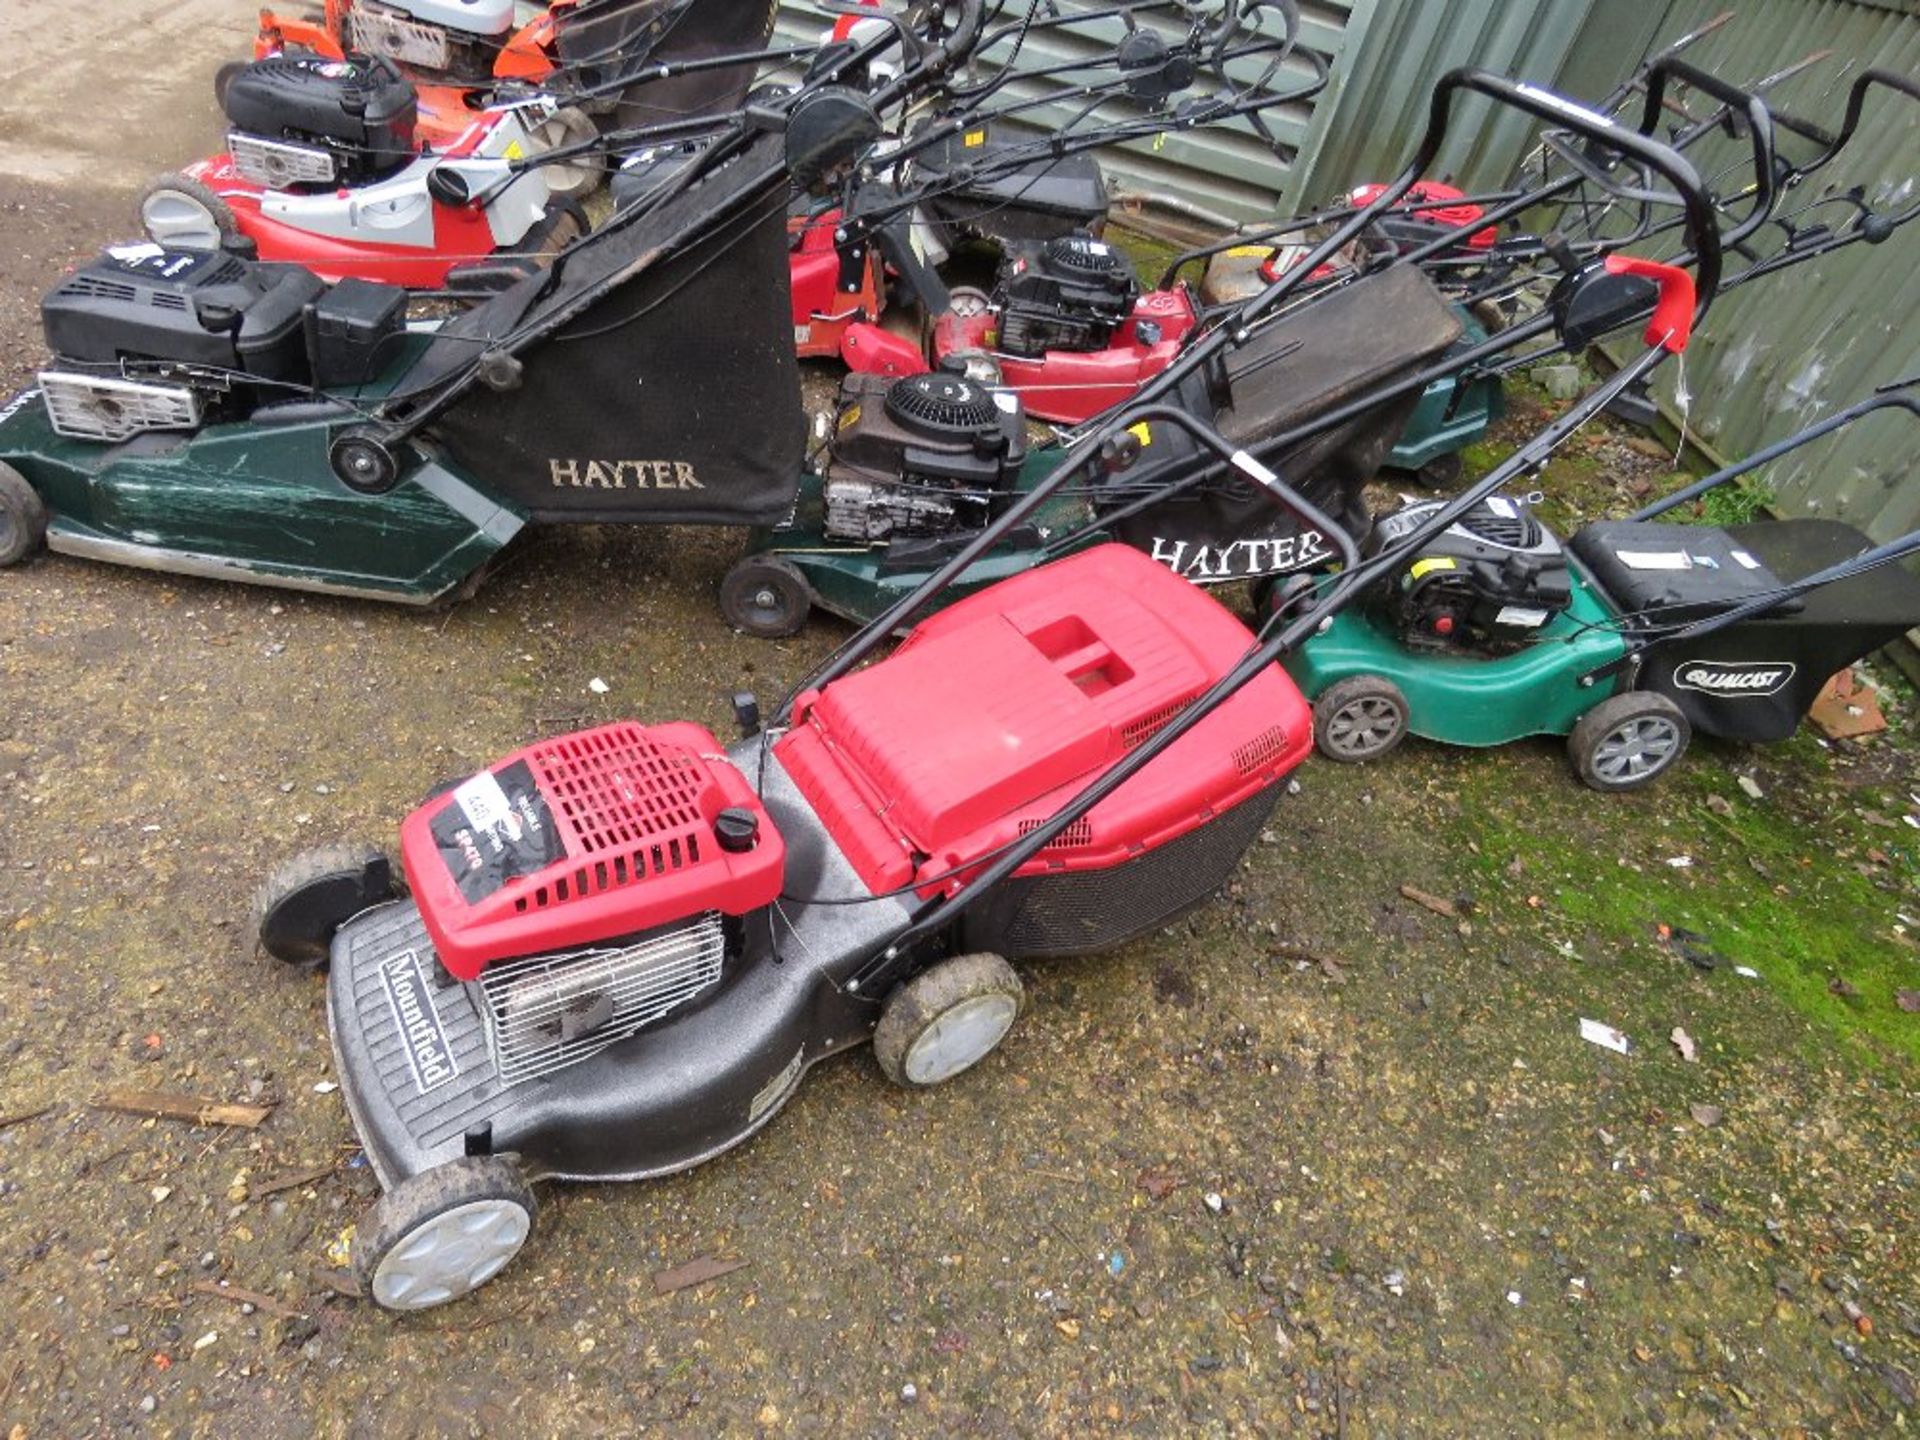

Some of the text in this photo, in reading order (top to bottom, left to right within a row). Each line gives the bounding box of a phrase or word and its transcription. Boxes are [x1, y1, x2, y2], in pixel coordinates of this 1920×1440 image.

[548, 458, 706, 491] HAYTER
[1151, 530, 1327, 577] HAYTER
[454, 828, 483, 870] SP470
[385, 953, 451, 1086] Mountfield
